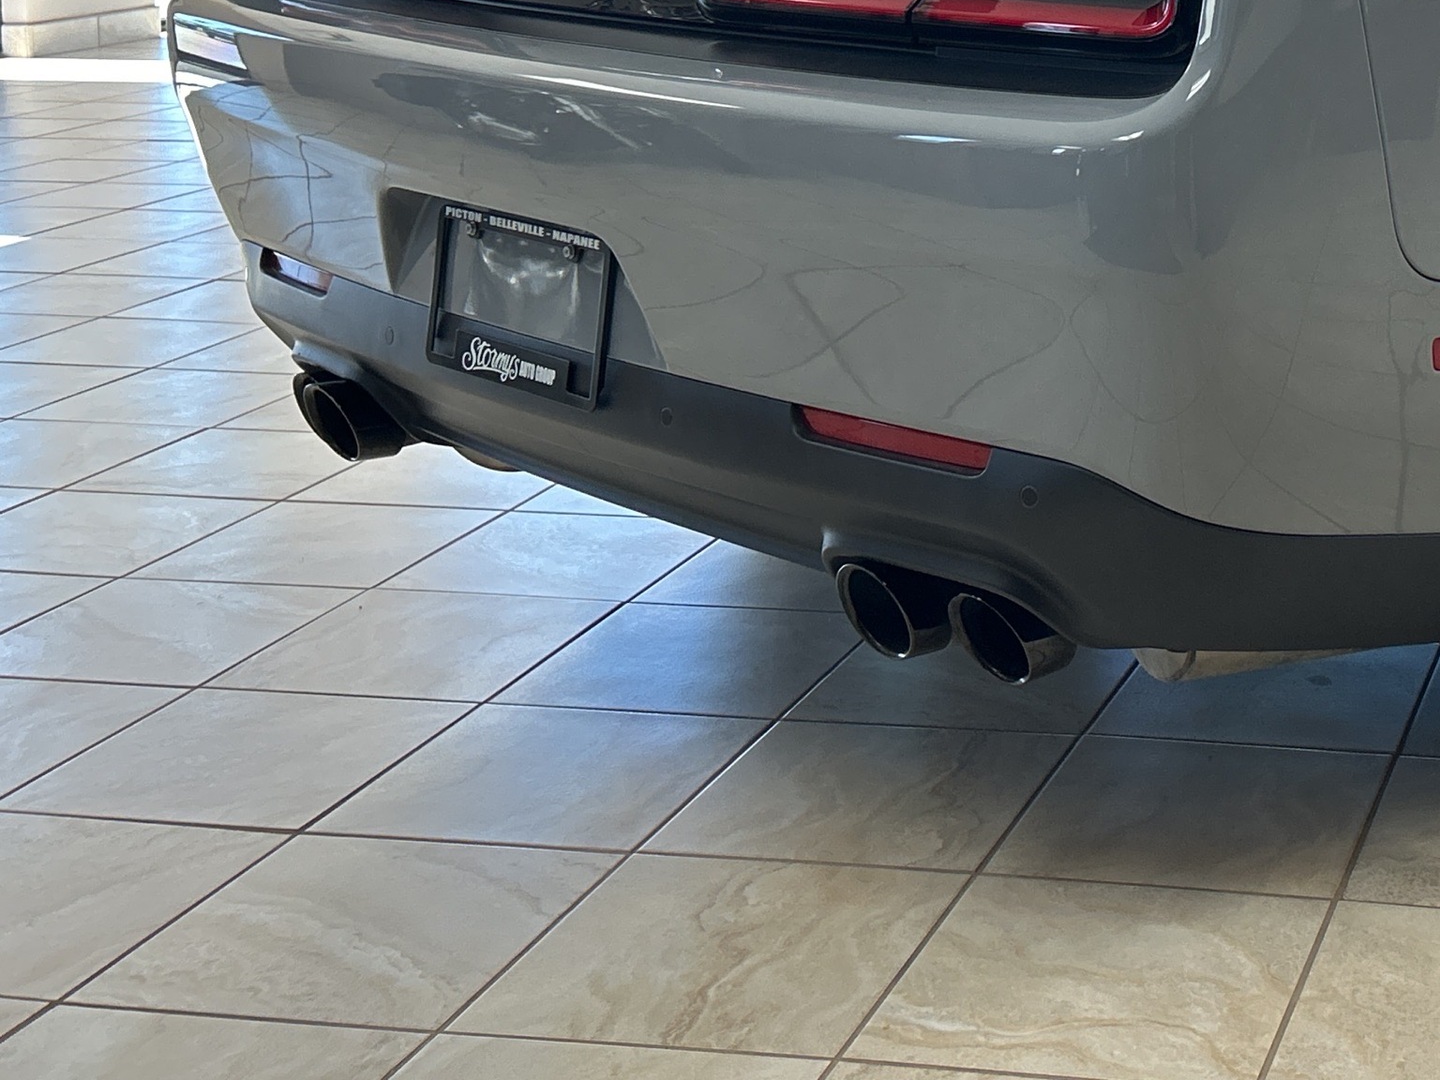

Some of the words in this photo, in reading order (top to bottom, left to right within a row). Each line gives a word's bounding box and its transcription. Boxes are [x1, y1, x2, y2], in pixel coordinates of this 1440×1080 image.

[445, 206, 483, 223] PICTON
[489, 215, 545, 237] BELLEVILLE
[552, 230, 601, 251] NAPANEE
